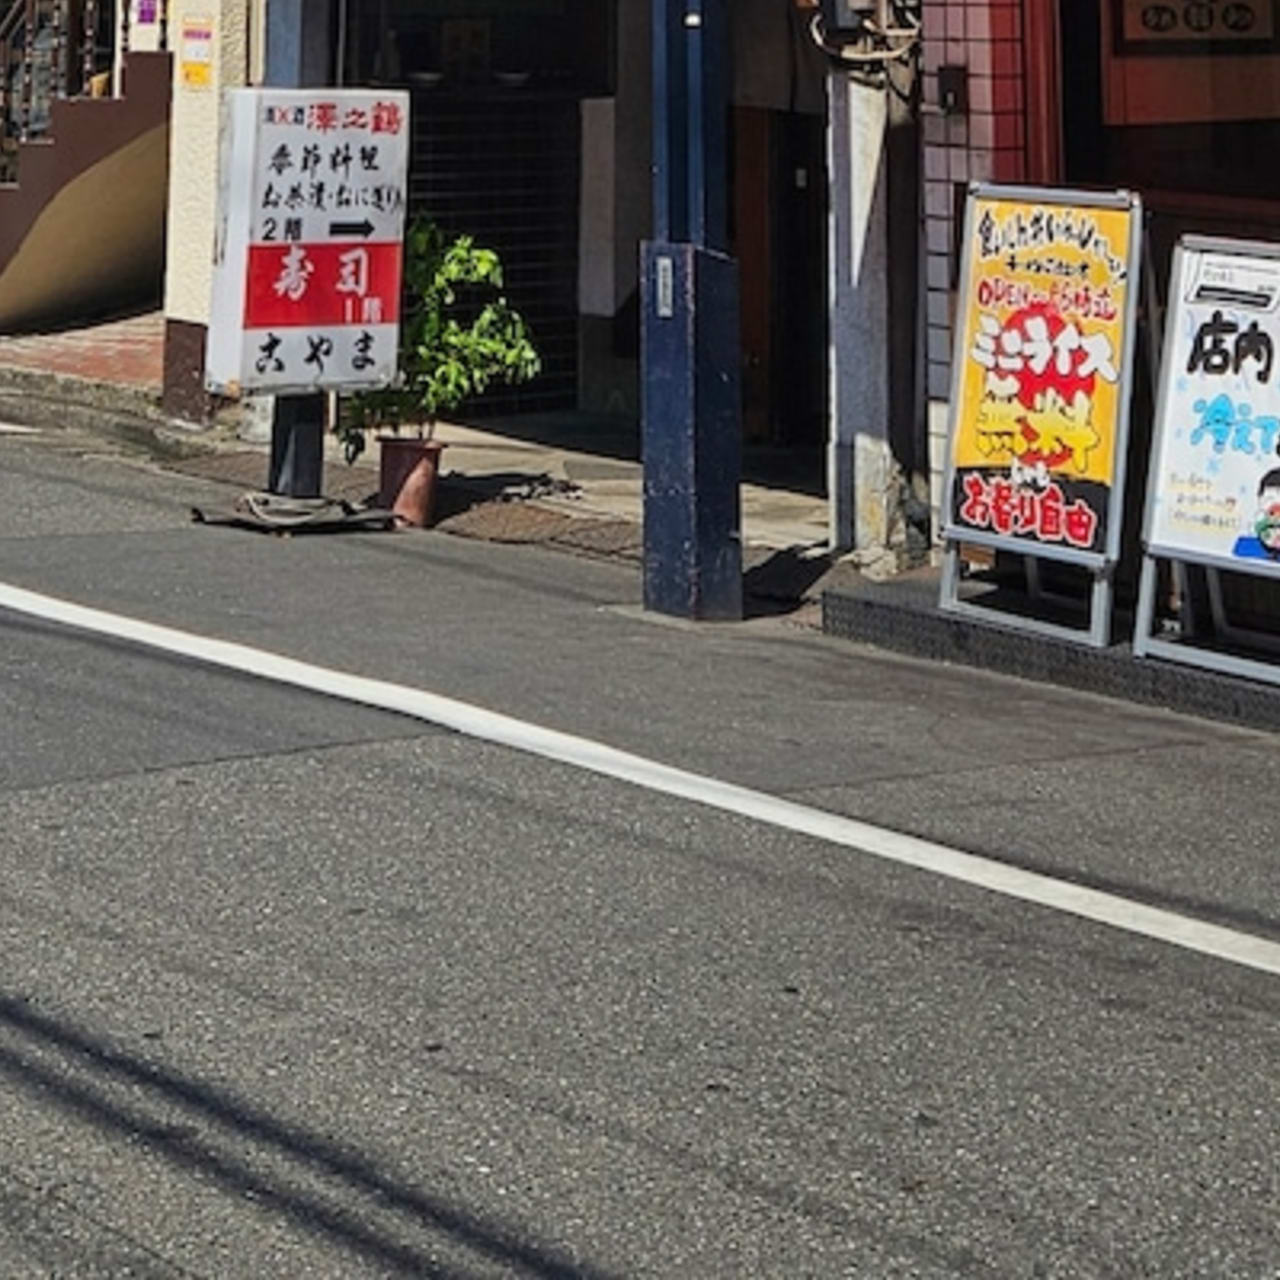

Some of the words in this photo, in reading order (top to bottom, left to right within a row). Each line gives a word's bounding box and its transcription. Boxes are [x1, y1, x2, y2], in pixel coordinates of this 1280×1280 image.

[268, 142, 380, 182] 季節料理
[272, 243, 370, 301] 寿司
[970, 314, 1120, 385] ミニライス
[1186, 309, 1276, 384] 店内
